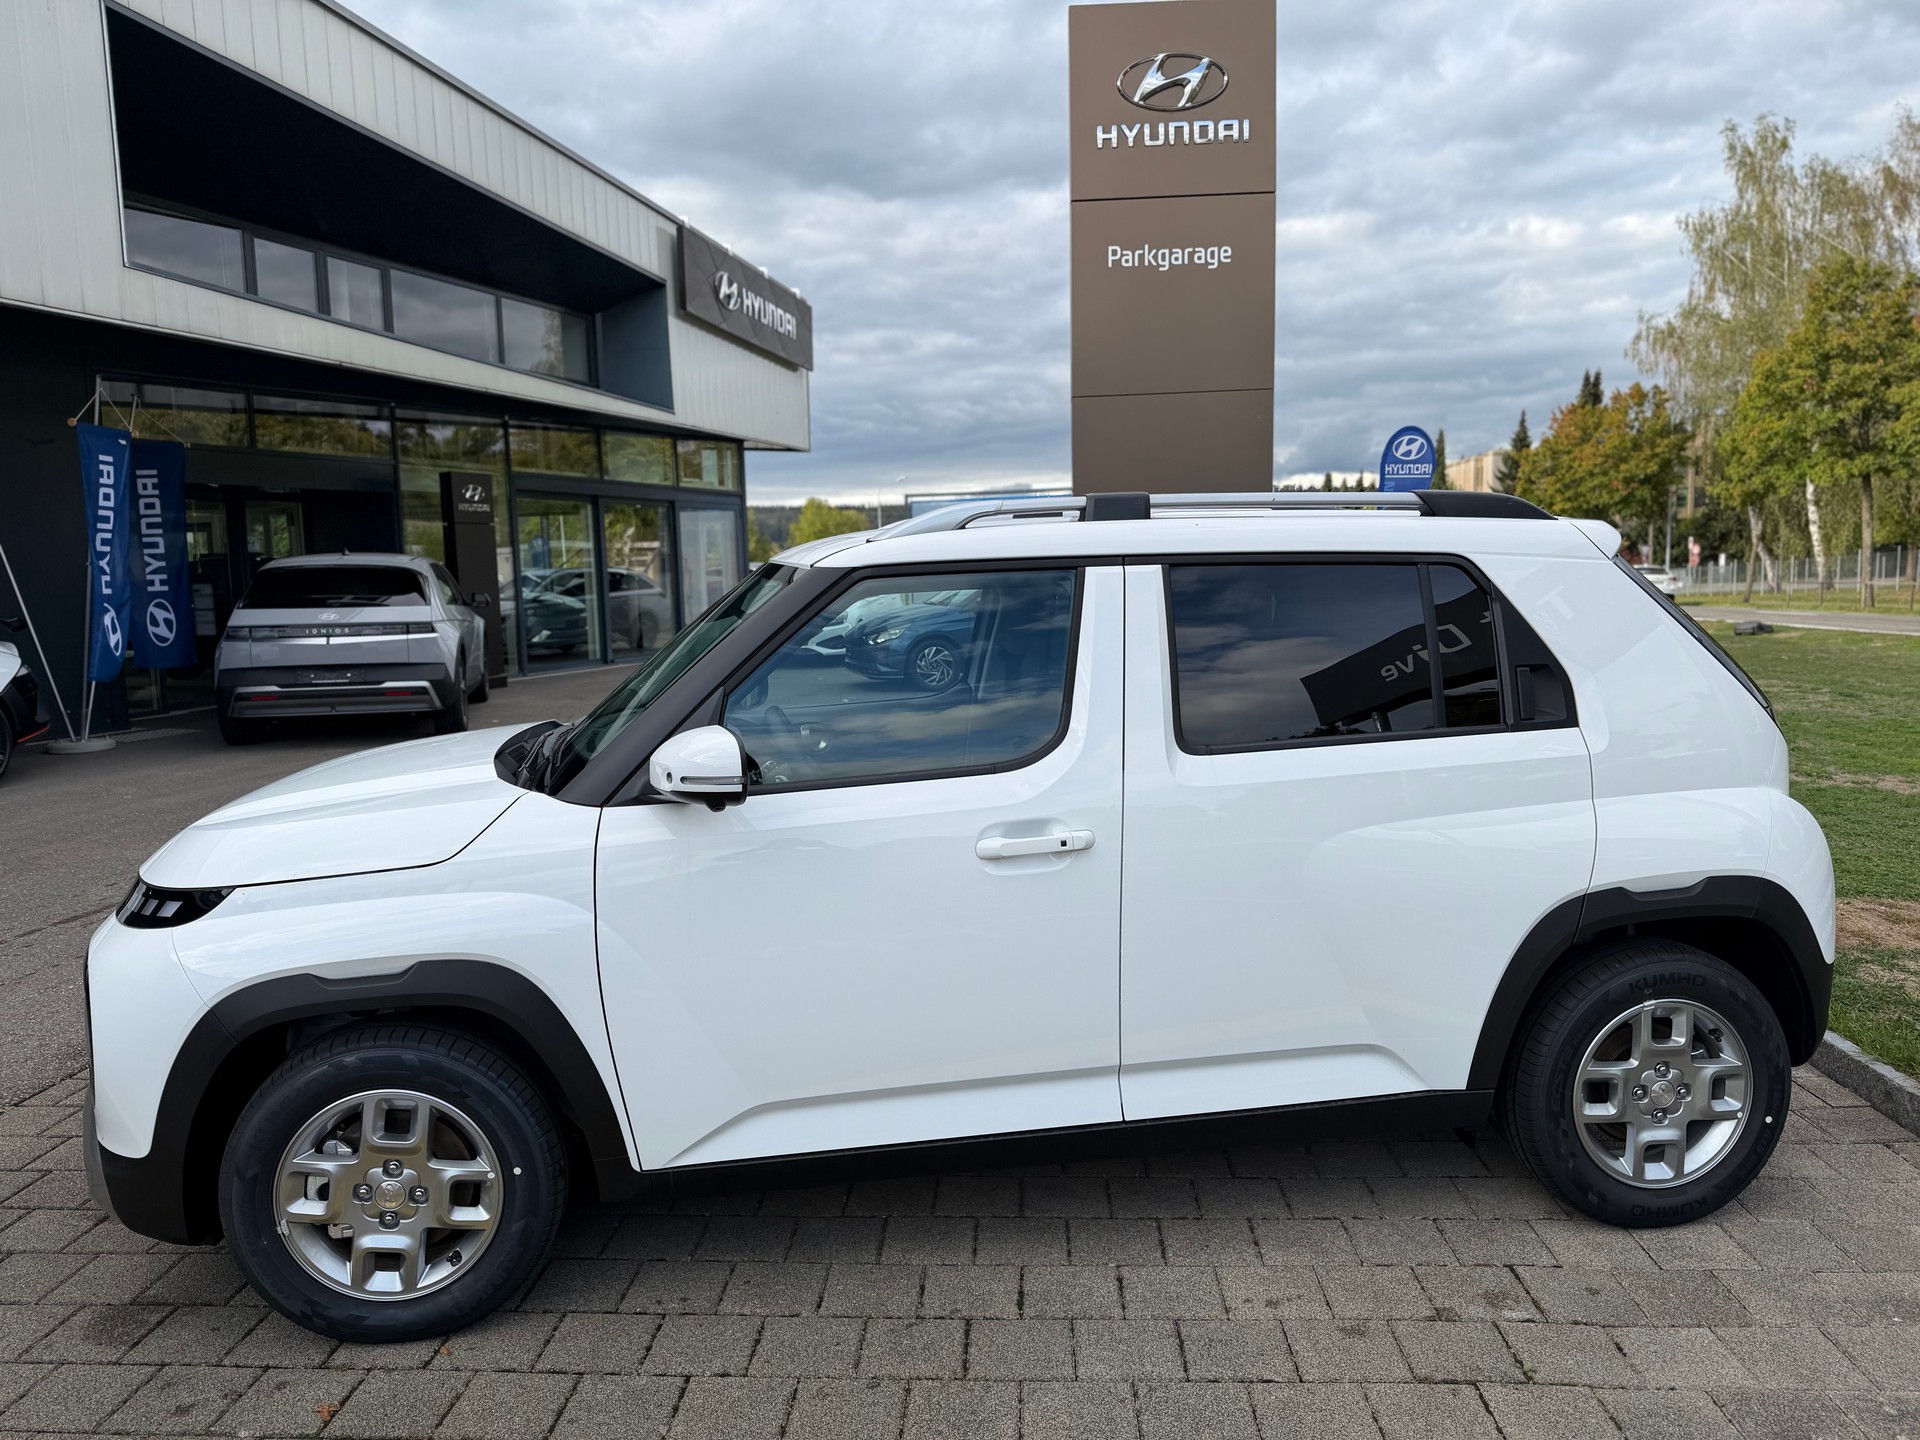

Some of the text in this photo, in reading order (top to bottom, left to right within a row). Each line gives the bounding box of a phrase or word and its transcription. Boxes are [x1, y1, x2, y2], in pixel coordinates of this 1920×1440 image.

[1096, 118, 1250, 149] HYUNDAI
[1107, 244, 1232, 271] Parkgarage
[742, 287, 797, 341] HYUNDAI
[1384, 463, 1433, 475] HYUNDAI
[135, 469, 169, 592] HYUNDAI
[1627, 972, 1707, 995] KUMHO
[1630, 1196, 1708, 1218] KUMHO
